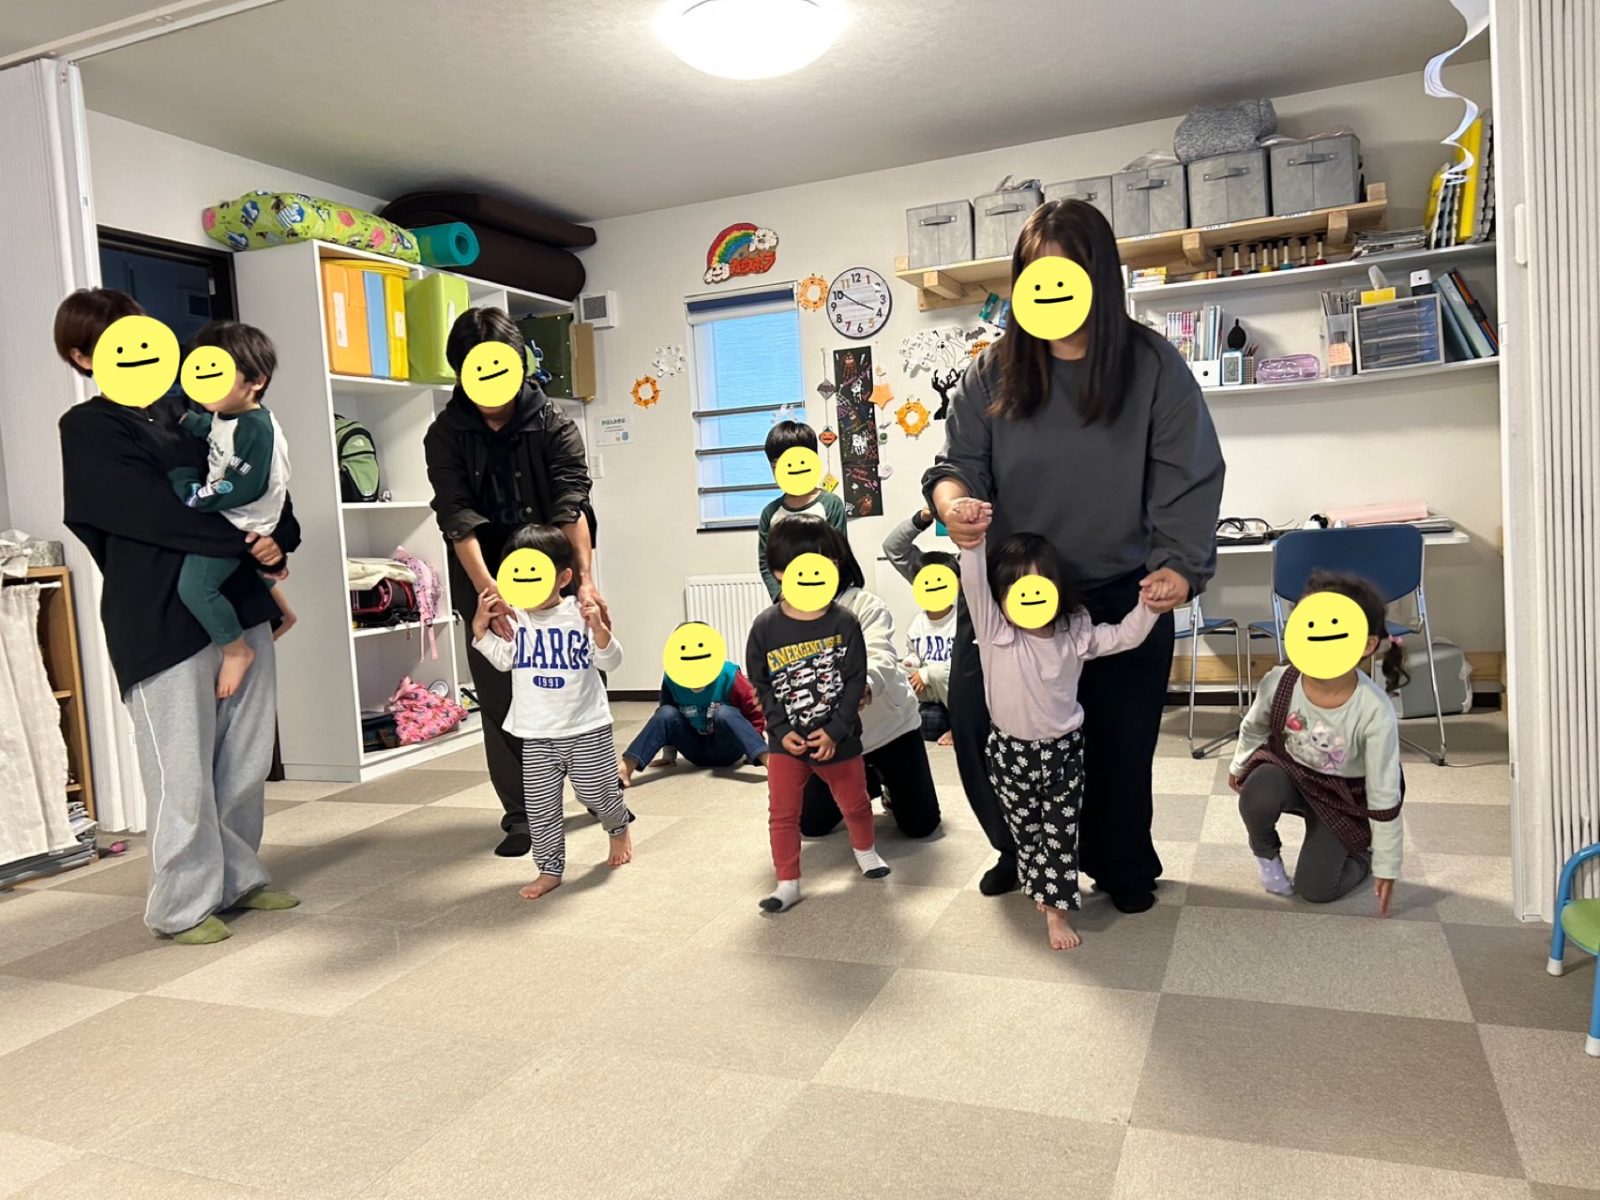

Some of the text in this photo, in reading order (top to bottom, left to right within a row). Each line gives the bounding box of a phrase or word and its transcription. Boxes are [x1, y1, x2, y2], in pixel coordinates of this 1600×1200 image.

[851, 273, 861, 283] 12
[865, 275, 871, 284] 1
[841, 279, 849, 288] 11
[832, 291, 843, 300] 10
[880, 295, 886, 304] 3
[831, 302, 837, 312] 9
[876, 308, 882, 317] 4
[836, 314, 842, 323] 8
[868, 318, 875, 328] 5
[845, 321, 851, 331] 7
[857, 323, 863, 333] 6
[538, 676, 559, 688] 1991
